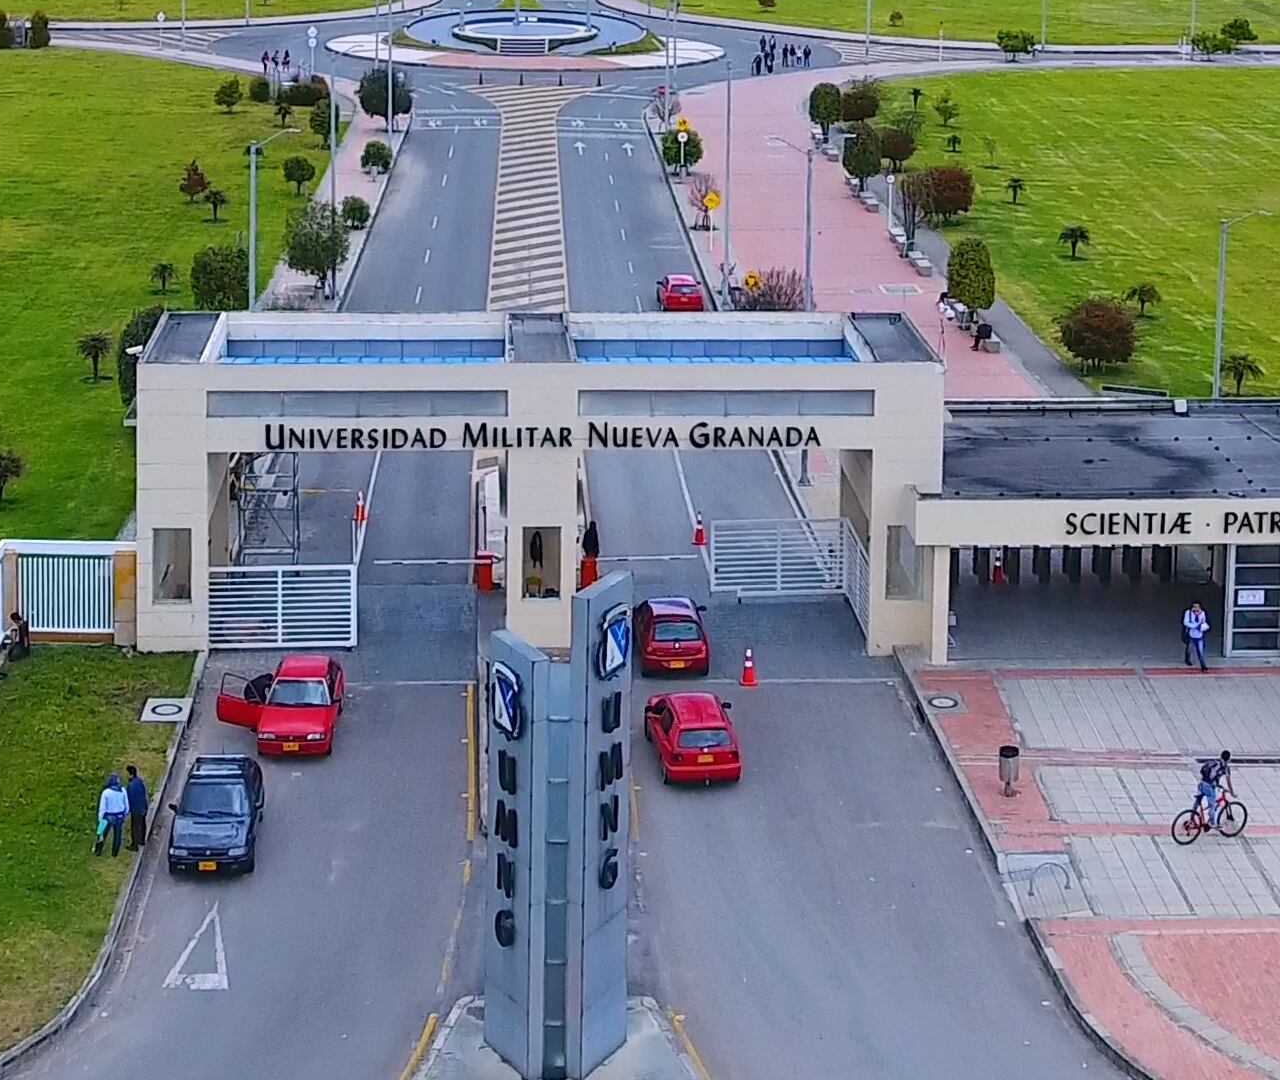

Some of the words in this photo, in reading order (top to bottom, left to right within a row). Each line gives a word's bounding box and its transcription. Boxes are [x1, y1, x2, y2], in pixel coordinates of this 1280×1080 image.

[265, 423, 447, 450] UNIVERSIDAD
[462, 422, 572, 448] MILITAR
[588, 421, 679, 448] NUEVA
[689, 421, 821, 448] GRANADA
